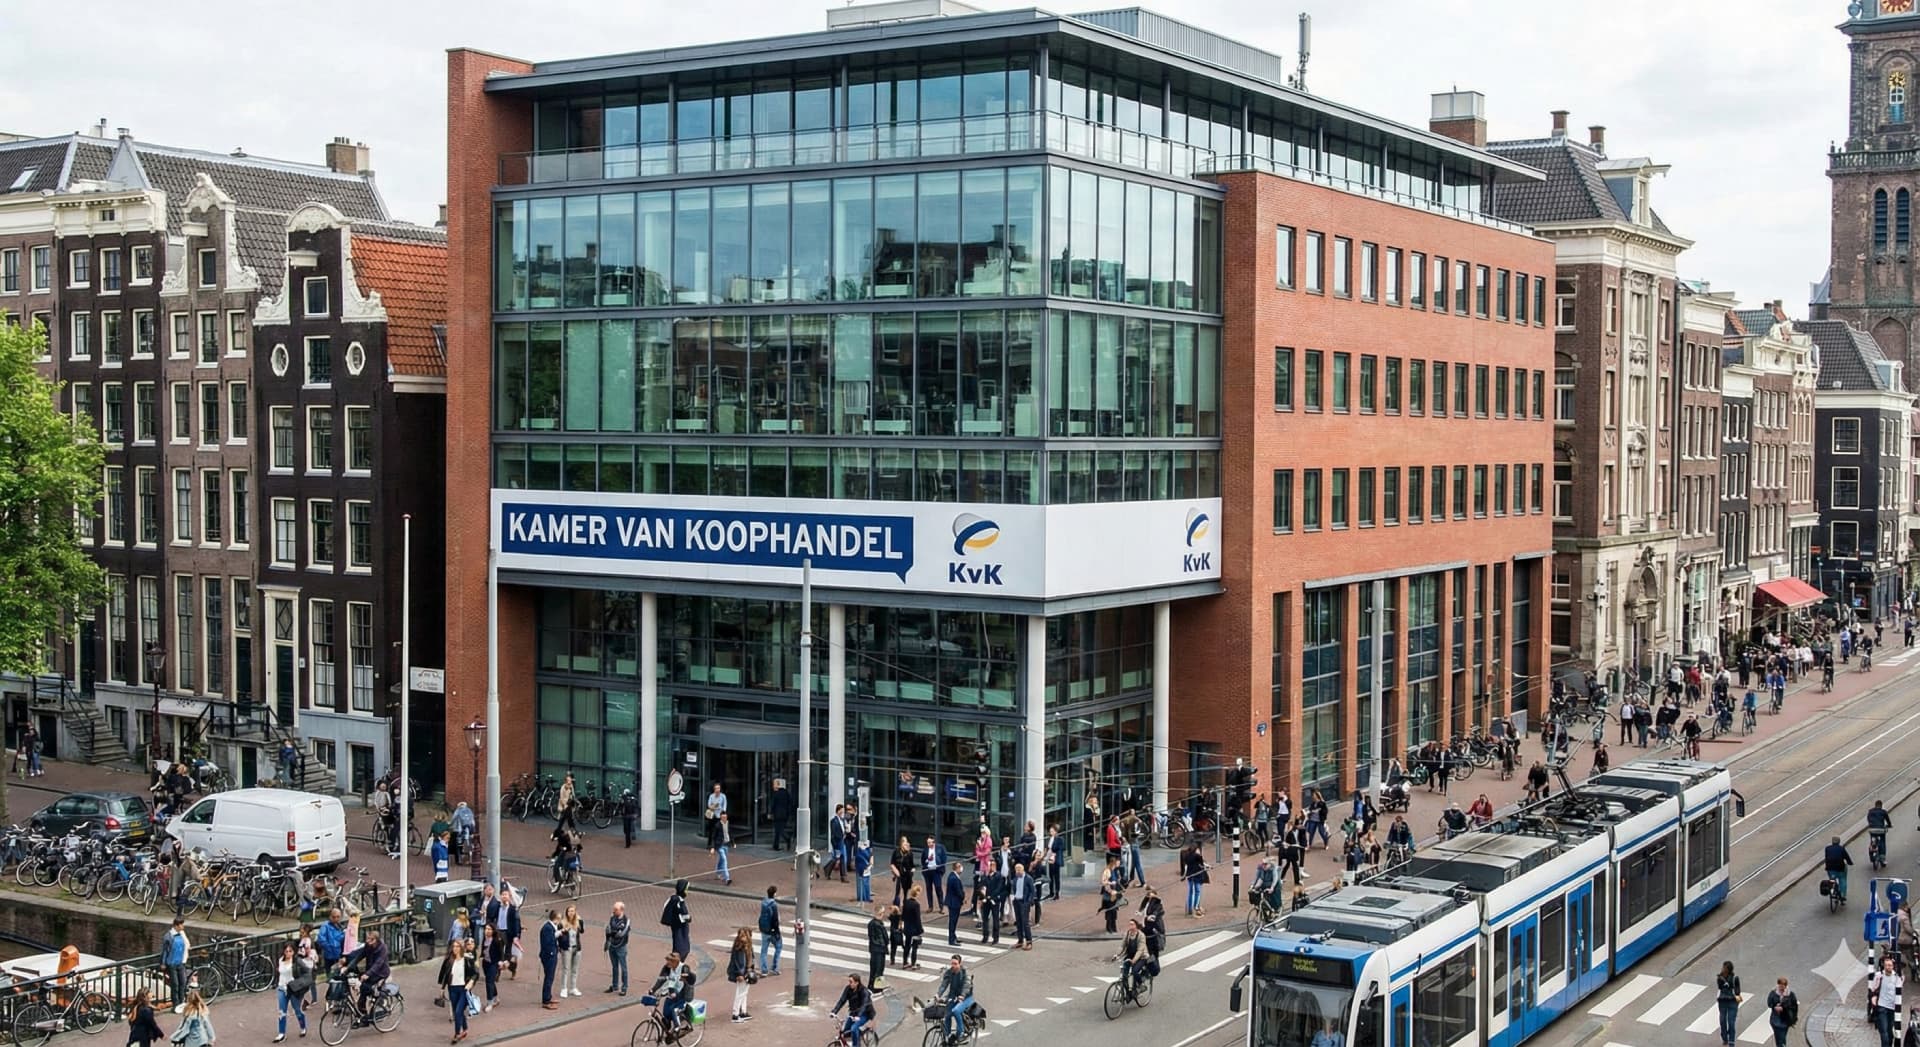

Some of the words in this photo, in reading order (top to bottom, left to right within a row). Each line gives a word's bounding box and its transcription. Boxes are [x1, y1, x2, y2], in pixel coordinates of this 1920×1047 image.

[509, 512, 607, 546] KAMER
[616, 517, 674, 549] VAN
[685, 519, 904, 559] KOOPHANDEL
[949, 562, 1003, 585] KvK
[1183, 552, 1211, 573] KvK
